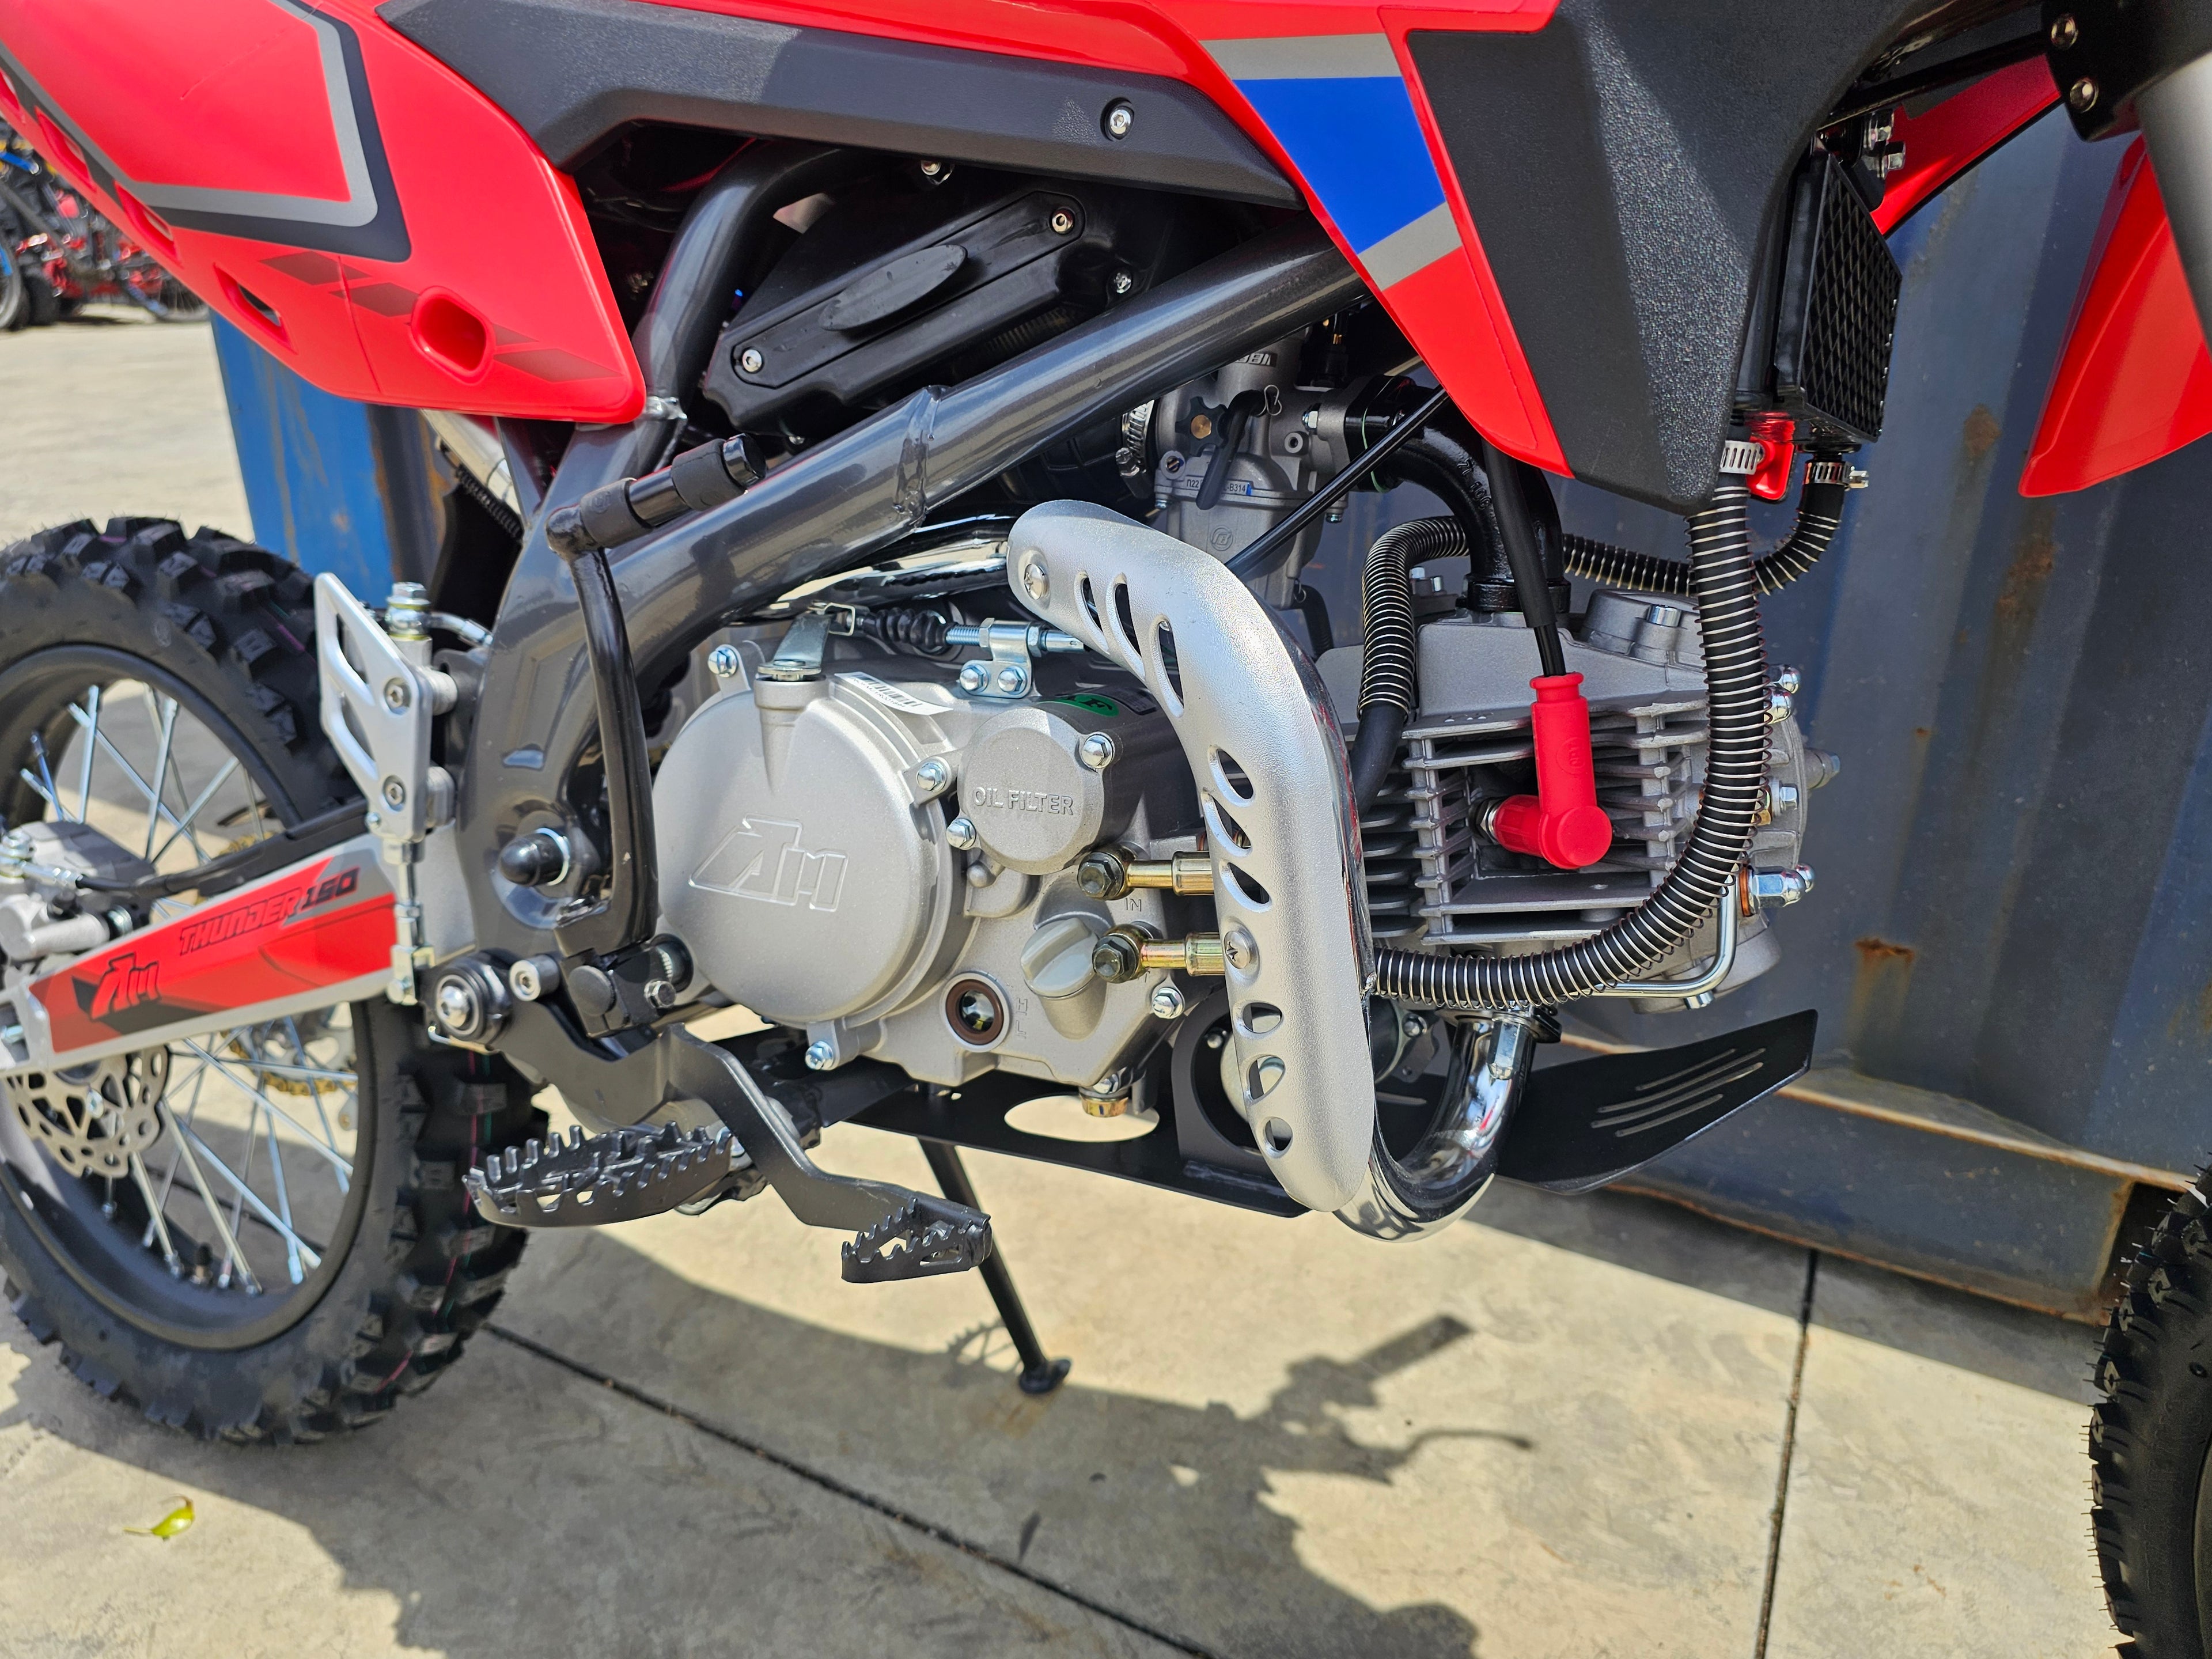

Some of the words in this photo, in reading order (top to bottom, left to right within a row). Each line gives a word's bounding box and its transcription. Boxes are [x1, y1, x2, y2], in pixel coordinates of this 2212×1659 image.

[972, 786, 1004, 808] OIL
[1007, 790, 1074, 816] FILTER
[179, 887, 303, 957] THUNDER
[301, 866, 361, 911] 150
[1125, 897, 1142, 912] IN
